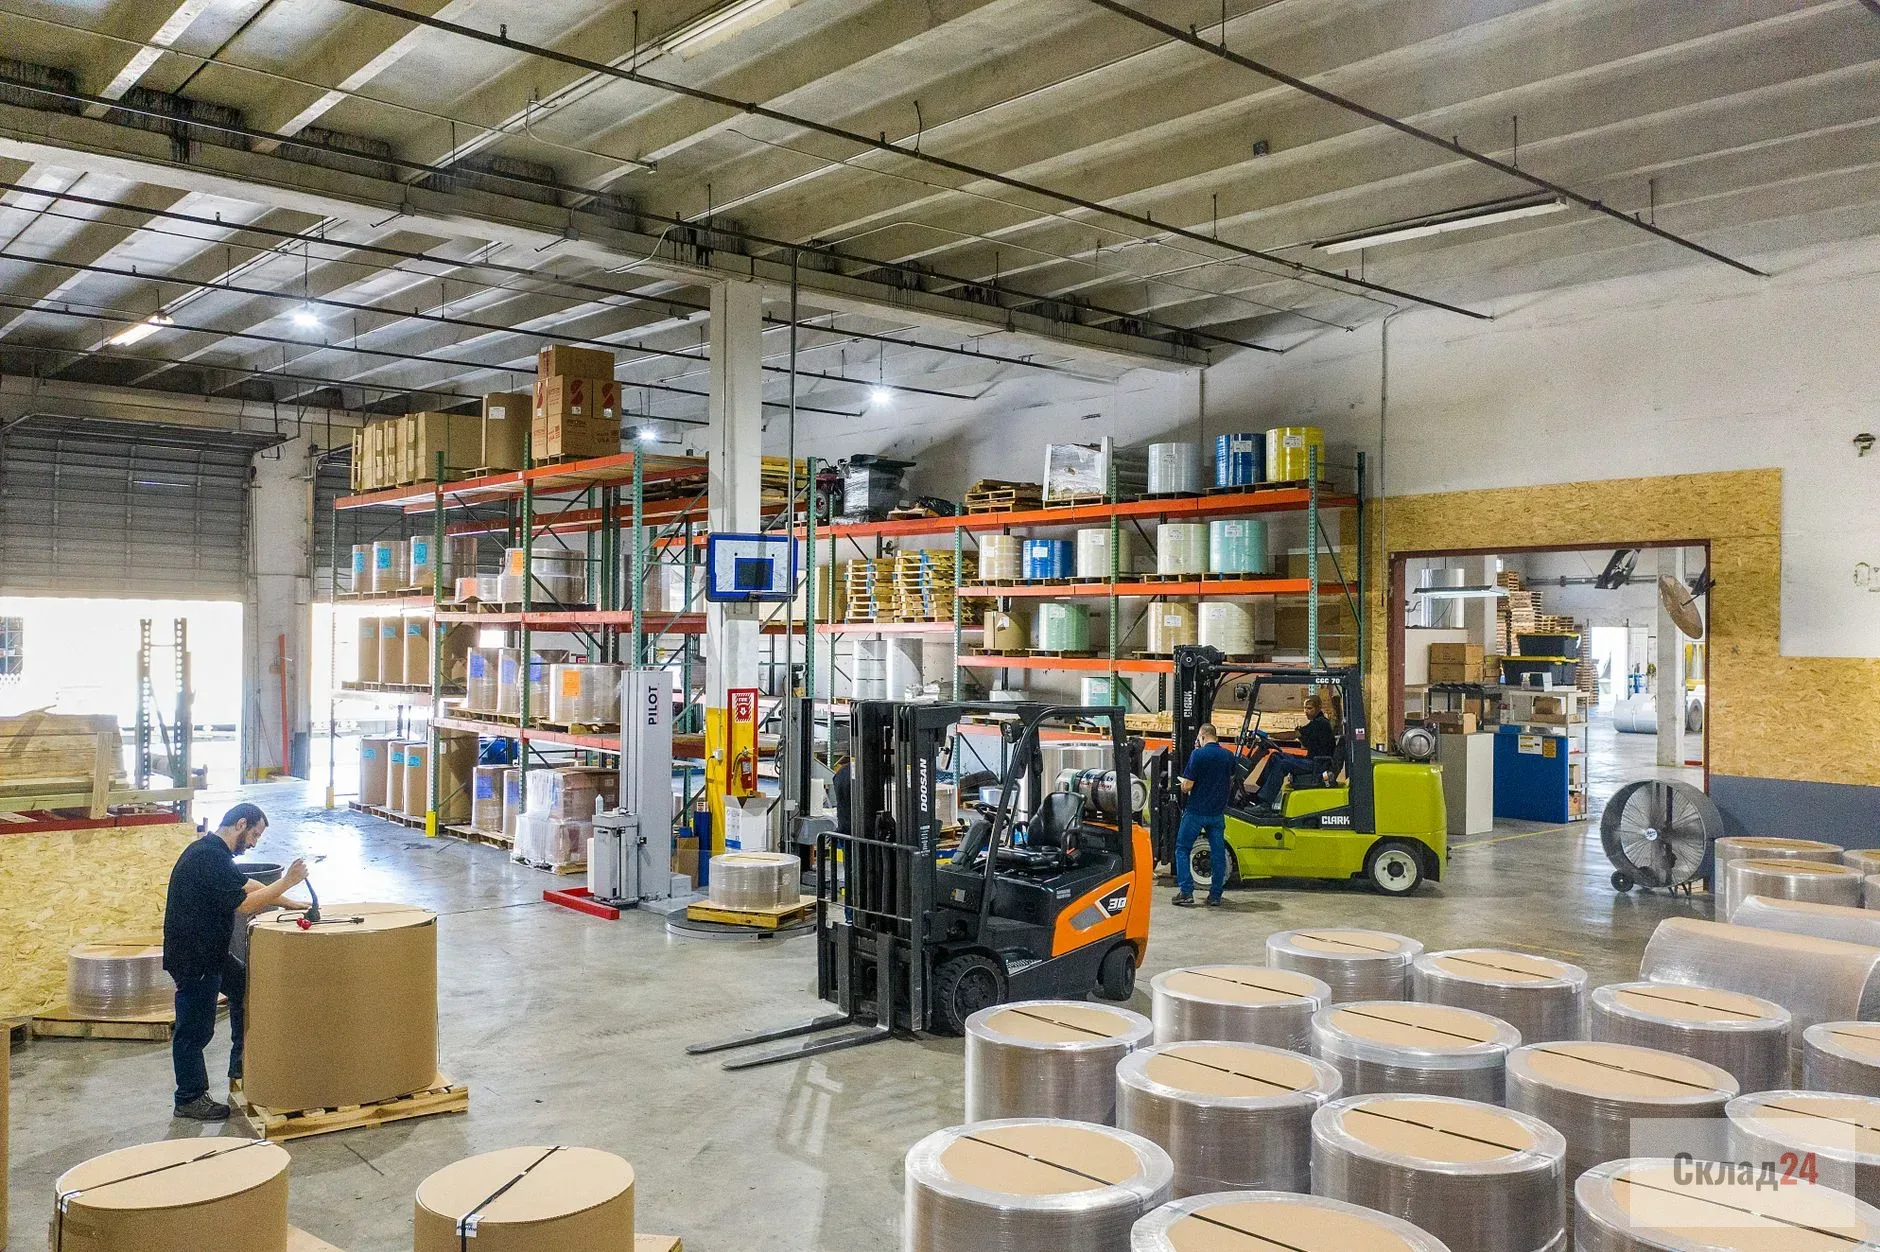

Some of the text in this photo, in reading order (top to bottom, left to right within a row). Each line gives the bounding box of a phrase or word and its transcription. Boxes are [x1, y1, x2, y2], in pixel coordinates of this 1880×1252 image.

[648, 686, 658, 725] PILOT
[1183, 690, 1193, 718] CLARK
[919, 758, 928, 812] DOOSAN
[1321, 815, 1350, 825] CLARK
[1107, 897, 1127, 912] 30
